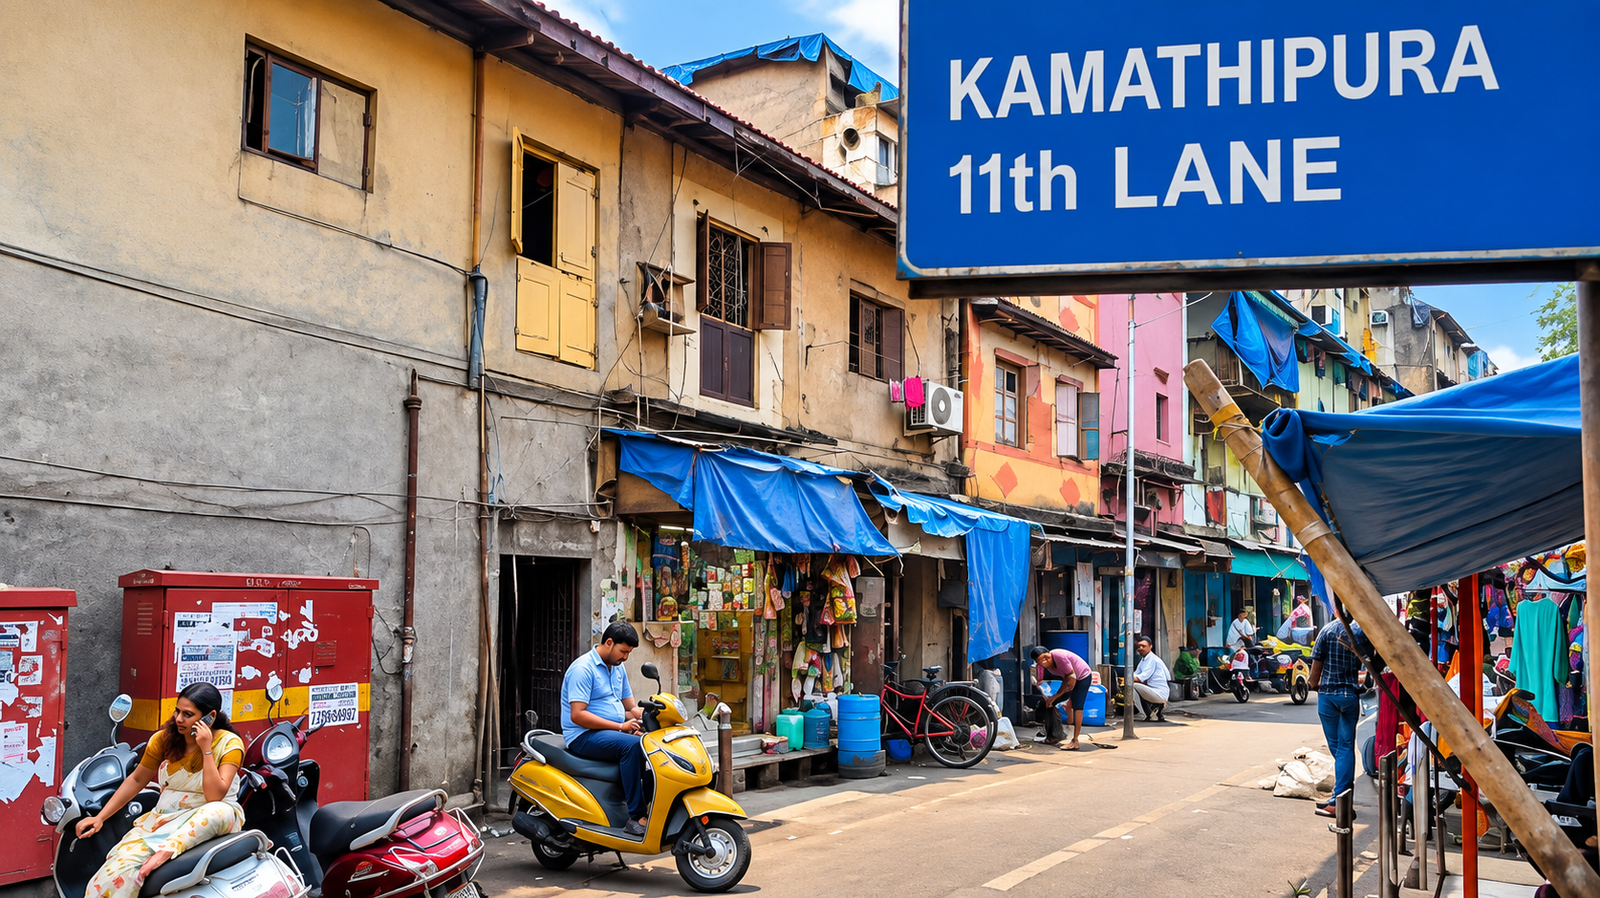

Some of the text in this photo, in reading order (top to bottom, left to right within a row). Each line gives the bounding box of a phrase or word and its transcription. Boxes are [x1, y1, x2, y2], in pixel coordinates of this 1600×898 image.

[949, 25, 1500, 121] KAMATHIPURA
[949, 136, 1342, 214] 11th LANE
